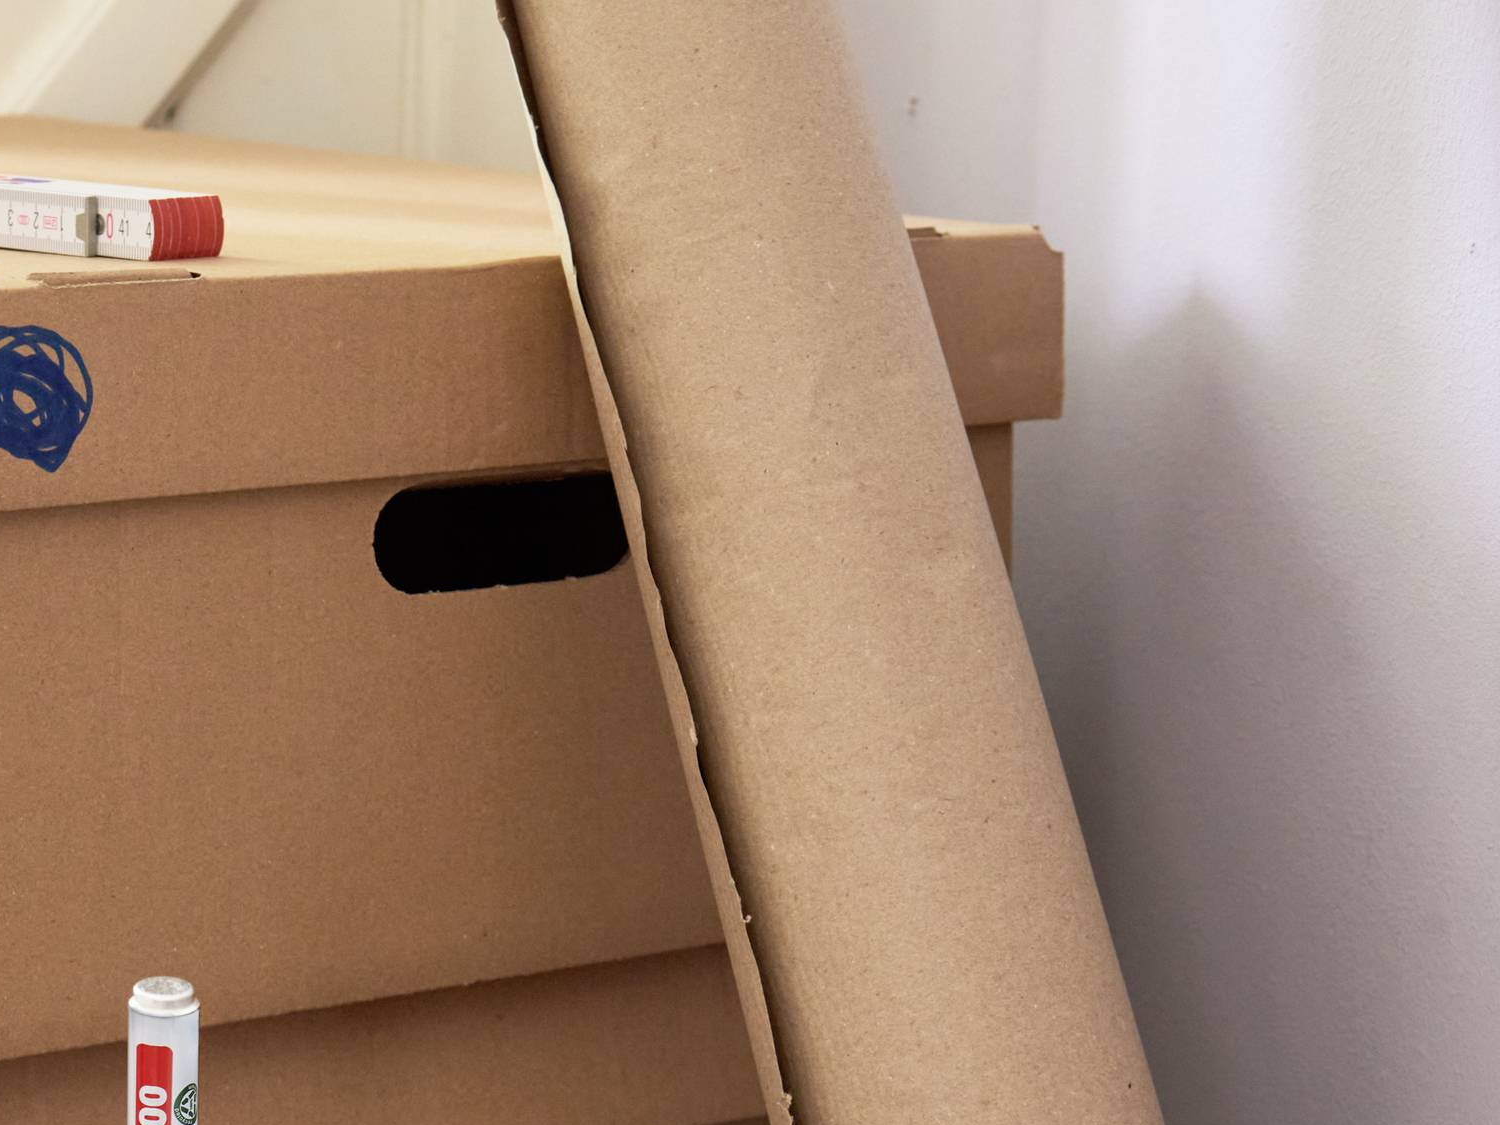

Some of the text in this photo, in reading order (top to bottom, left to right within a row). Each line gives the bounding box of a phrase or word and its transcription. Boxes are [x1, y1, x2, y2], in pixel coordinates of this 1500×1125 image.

[7, 209, 13, 227] 3
[33, 211, 39, 230] 2
[118, 219, 130, 238] 41
